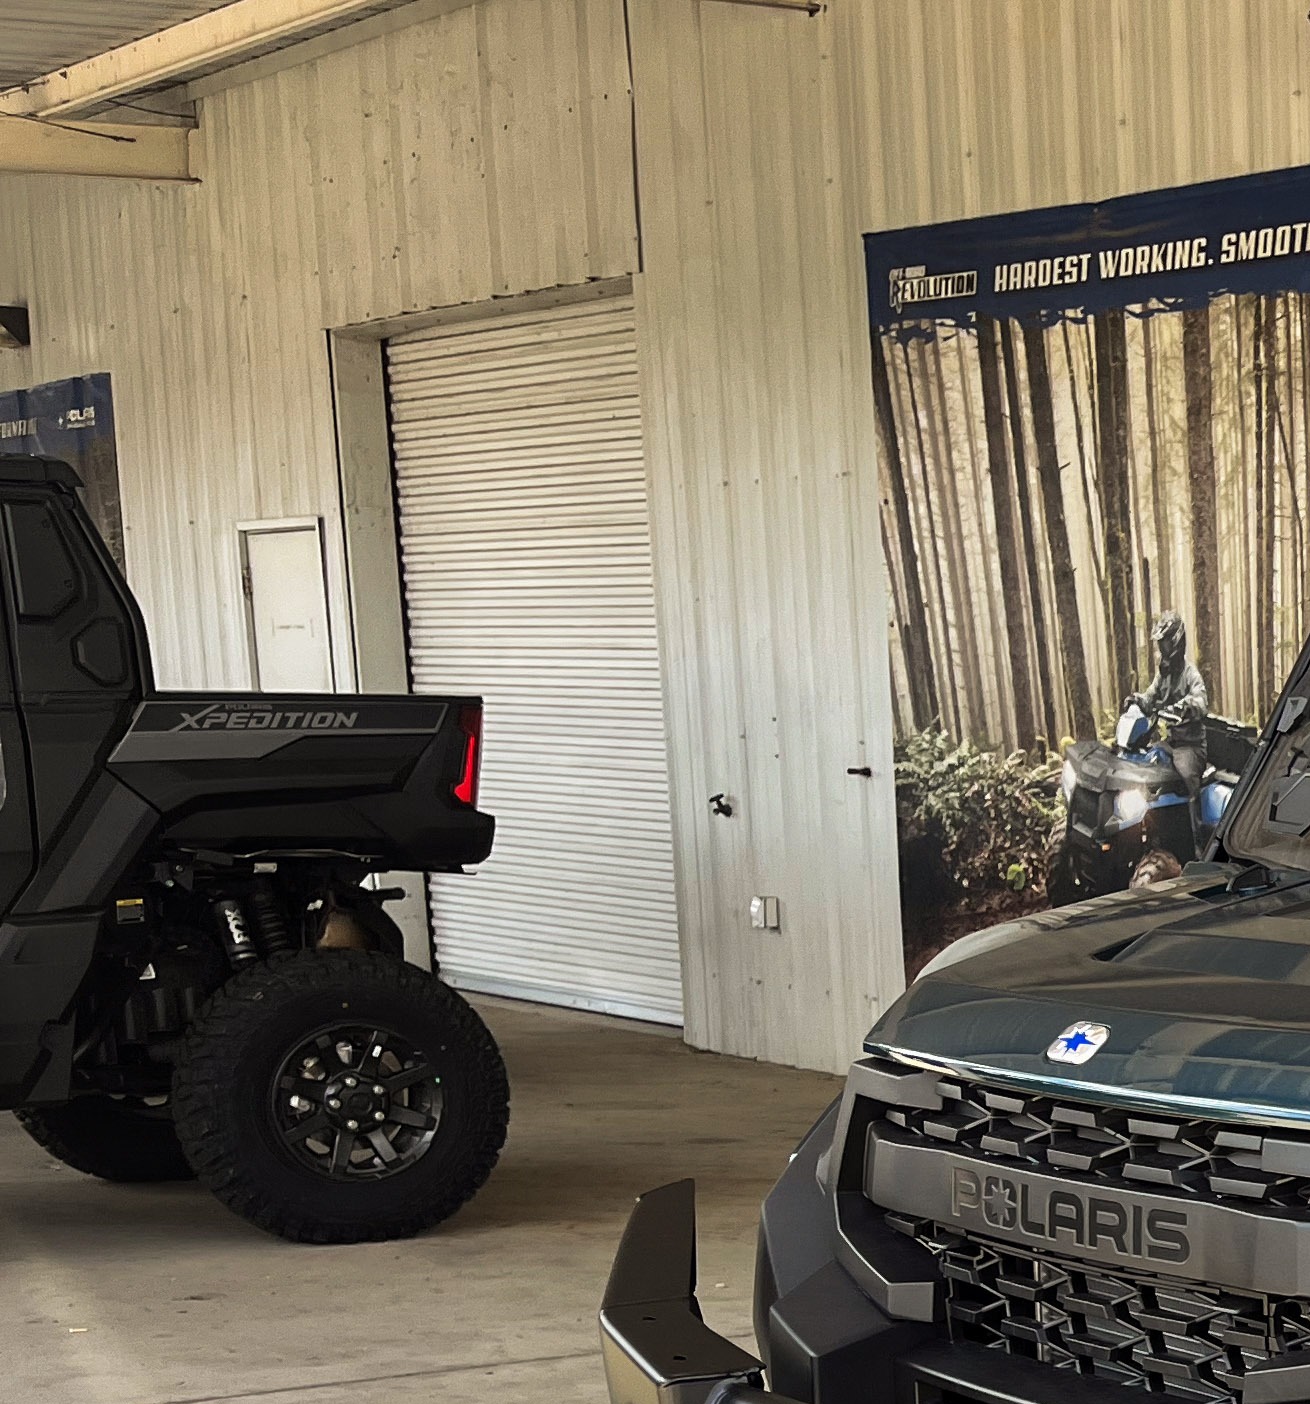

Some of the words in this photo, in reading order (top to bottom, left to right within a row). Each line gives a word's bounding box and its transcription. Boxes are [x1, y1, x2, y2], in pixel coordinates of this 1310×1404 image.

[994, 252, 1092, 293] HARDEST
[1099, 237, 1214, 280] WORKING.
[890, 271, 978, 314] REVOLUTION
[170, 704, 359, 732] XPEDITION
[951, 1166, 1191, 1266] POLARIS
